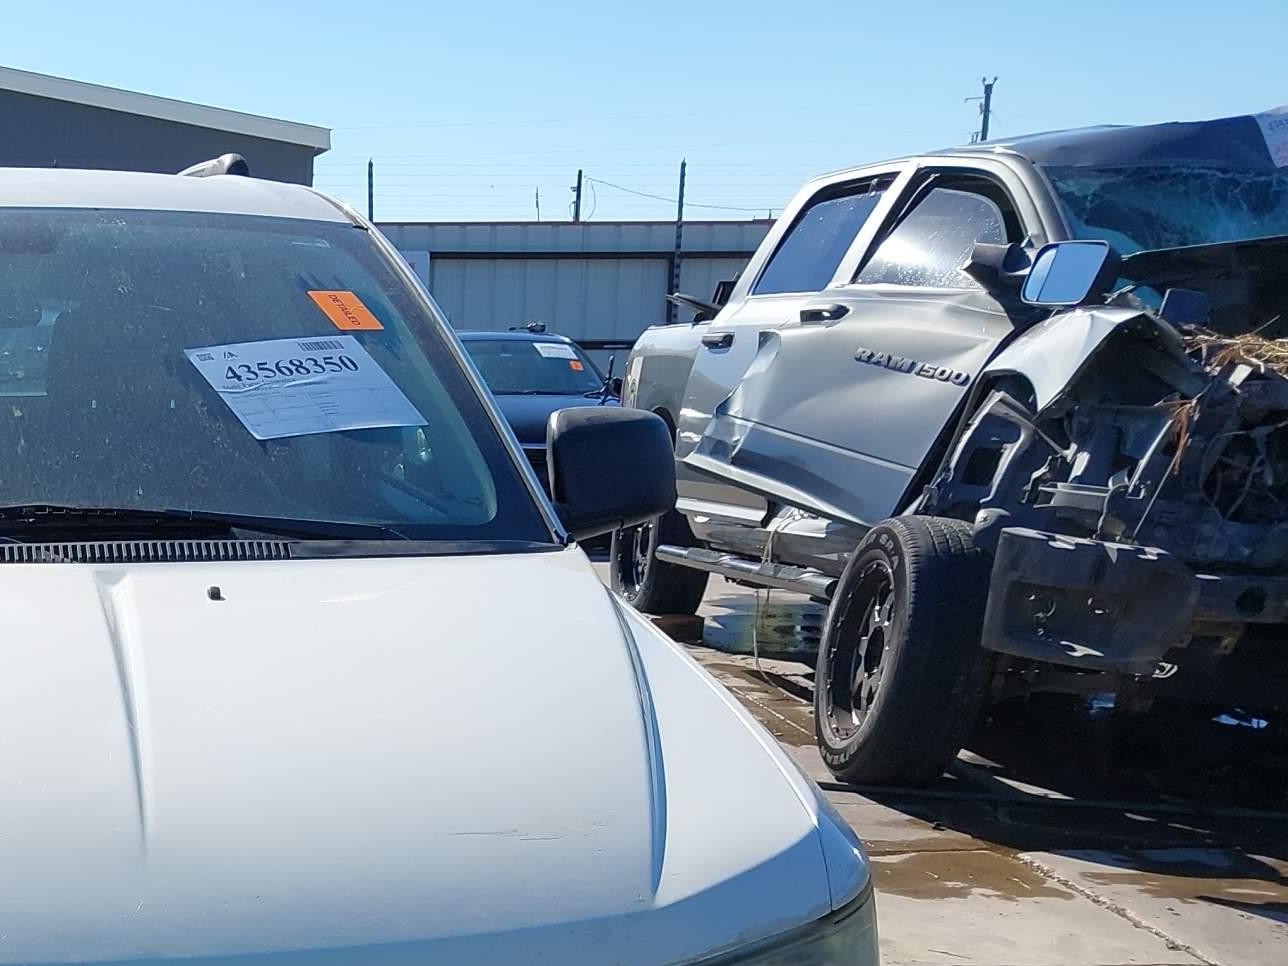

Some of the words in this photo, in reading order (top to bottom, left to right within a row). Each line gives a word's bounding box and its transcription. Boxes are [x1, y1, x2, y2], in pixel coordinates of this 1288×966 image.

[328, 294, 360, 326] DETAILED
[225, 355, 359, 382] 43568350
[854, 347, 914, 373] RAM
[913, 361, 970, 386] 1500
